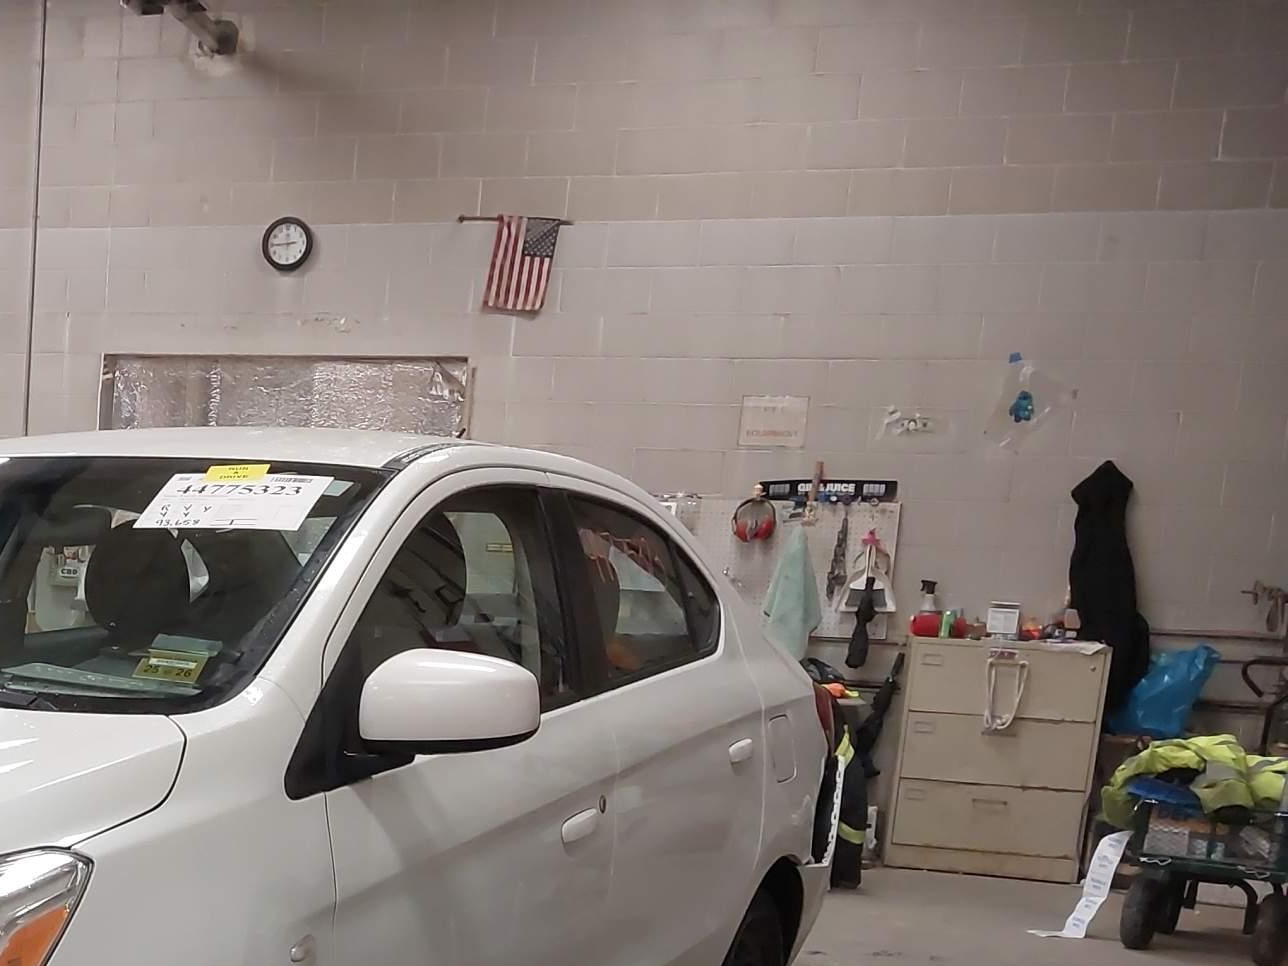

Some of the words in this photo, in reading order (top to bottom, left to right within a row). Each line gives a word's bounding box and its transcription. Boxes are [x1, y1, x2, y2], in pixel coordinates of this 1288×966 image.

[177, 484, 303, 497] 44775323
[825, 483, 856, 492] JUICE
[143, 664, 160, 674] 25
[175, 668, 192, 678] 26
